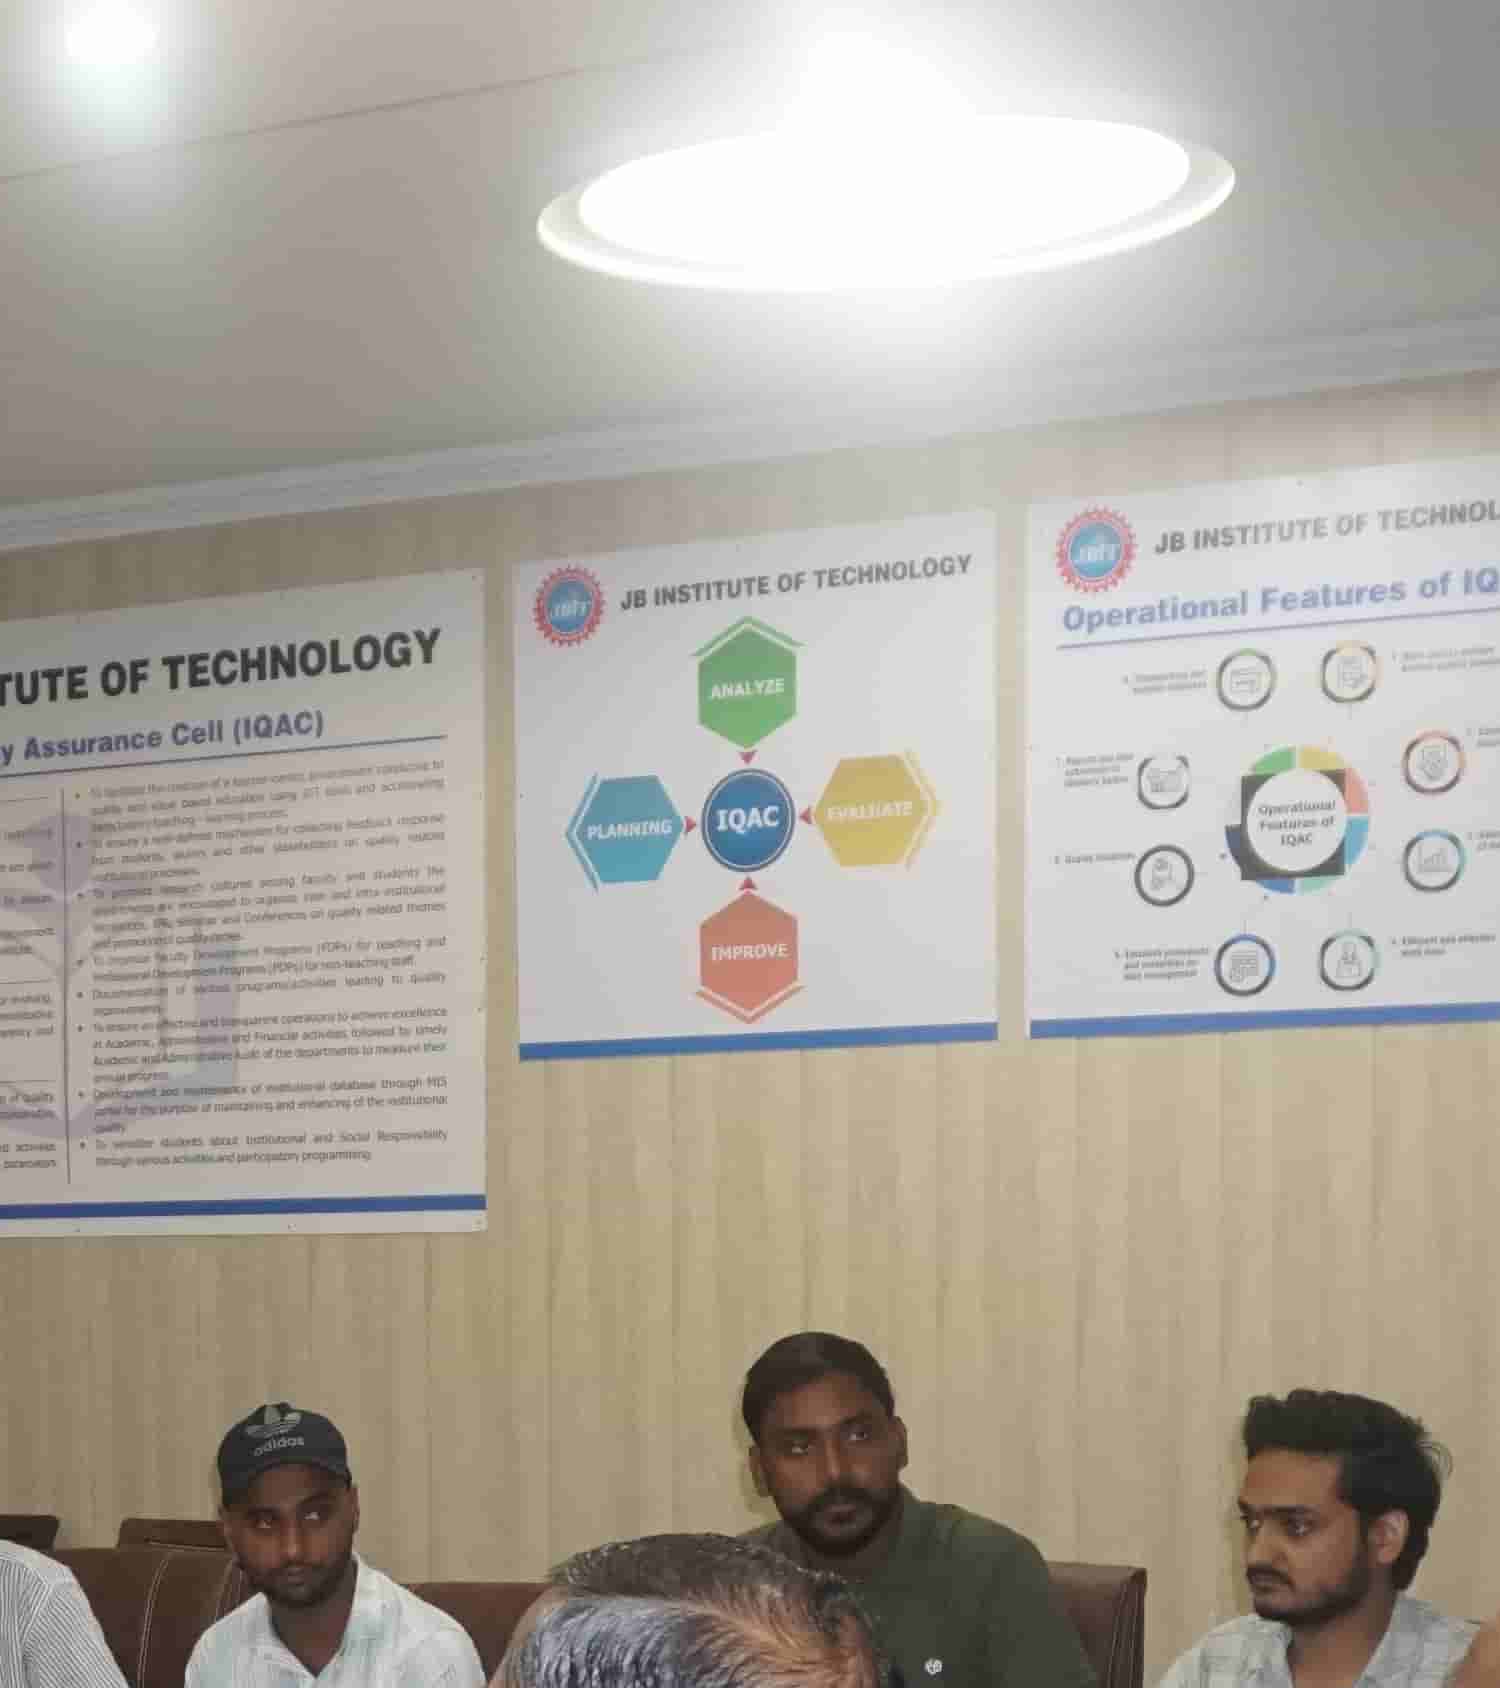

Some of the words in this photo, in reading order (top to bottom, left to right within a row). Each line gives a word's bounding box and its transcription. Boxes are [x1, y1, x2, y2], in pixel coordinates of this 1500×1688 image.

[1154, 532, 1185, 554] JB
[1193, 516, 1328, 549] INSTITUTE
[1337, 512, 1369, 536] OF
[620, 589, 646, 611] JB
[655, 576, 770, 606] INSTITUTE
[778, 570, 806, 593] OF
[815, 554, 972, 589] TECHNOLOGY
[1062, 587, 1248, 634] Operational
[1261, 577, 1406, 613] Features
[1420, 570, 1451, 598] of
[100, 659, 149, 696] OF
[162, 628, 440, 690] TECHNOLOGY
[709, 678, 784, 700] ANALYZE
[24, 728, 162, 760] Assurance
[171, 720, 223, 746] Cell
[233, 710, 323, 745] (IQAC)
[587, 821, 673, 840] PLANNING
[716, 807, 780, 835] IQAC
[710, 944, 789, 962] IMPROVE
[250, 1435, 305, 1457] adidas
